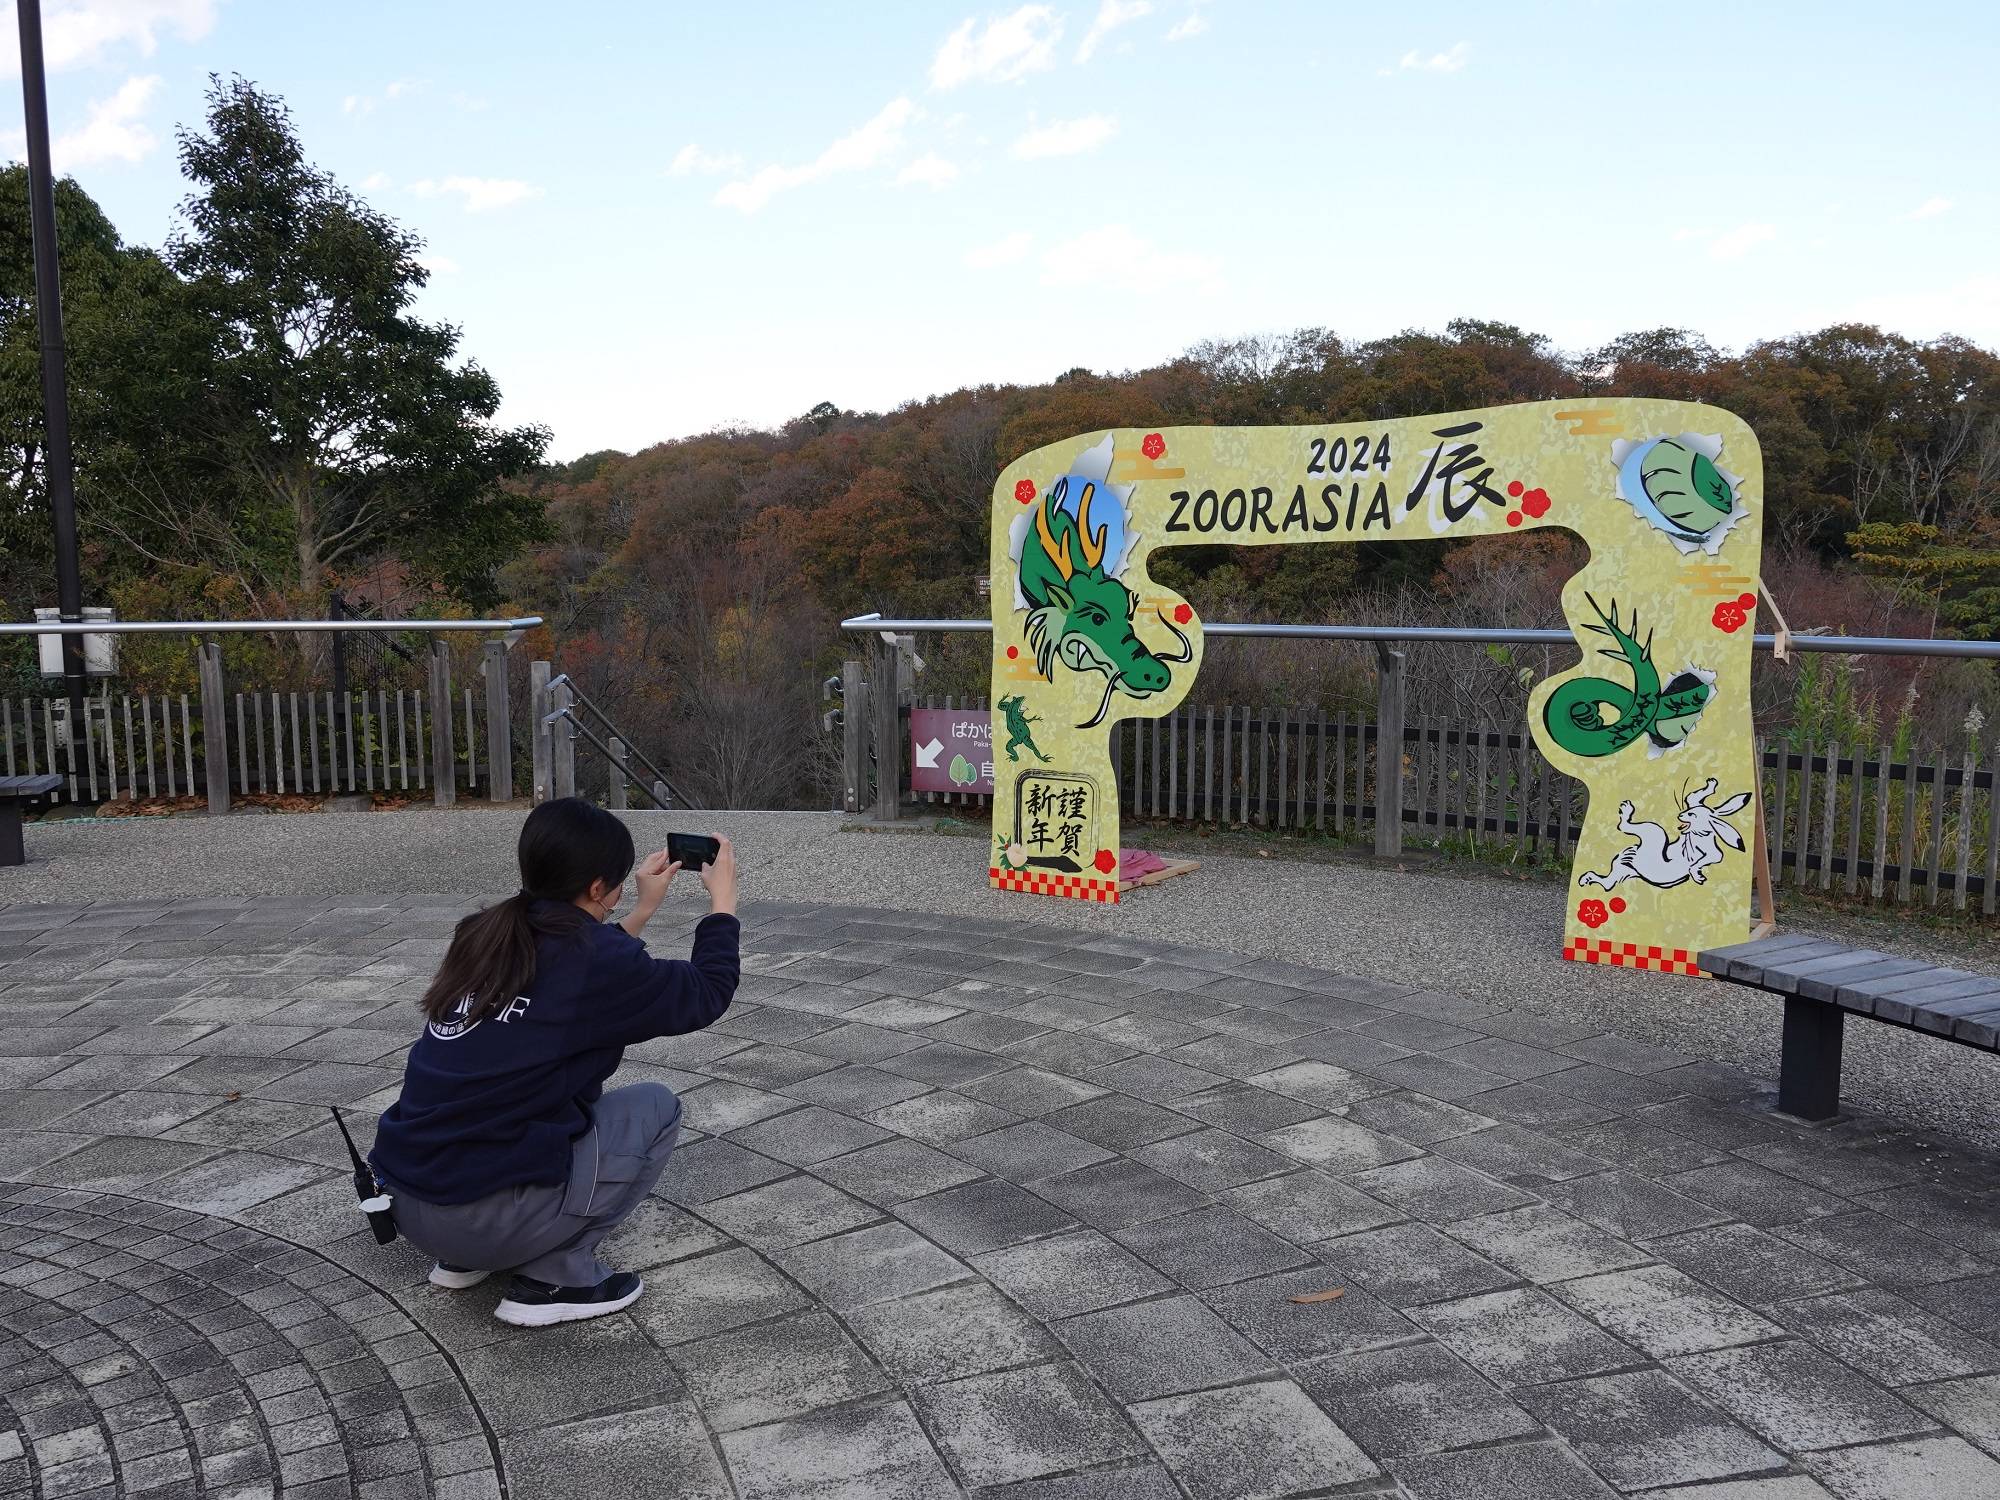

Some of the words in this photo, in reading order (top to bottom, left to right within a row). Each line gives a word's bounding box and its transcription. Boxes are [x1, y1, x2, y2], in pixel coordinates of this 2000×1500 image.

[1306, 432, 1392, 474] 2024
[1405, 421, 1507, 523] 辰
[1165, 481, 1392, 534] ZOORASIA
